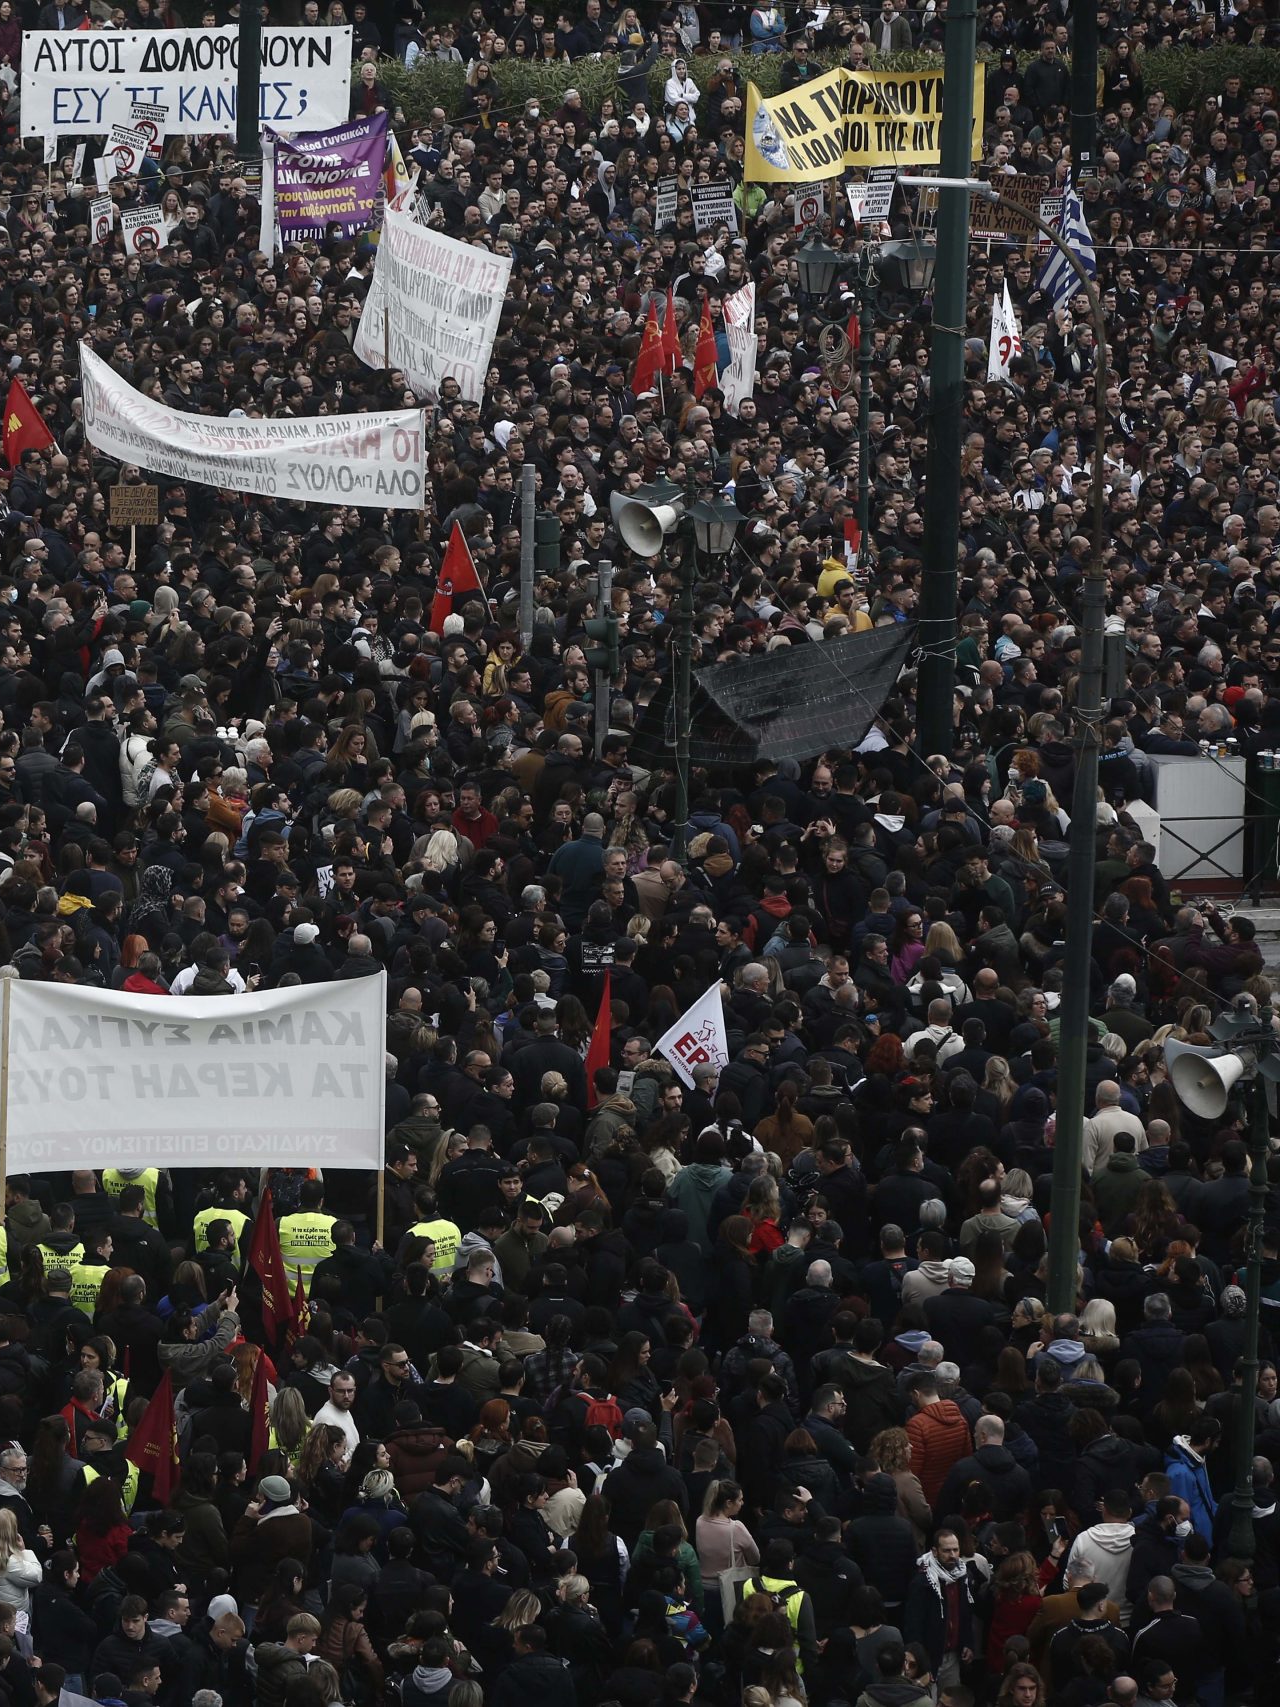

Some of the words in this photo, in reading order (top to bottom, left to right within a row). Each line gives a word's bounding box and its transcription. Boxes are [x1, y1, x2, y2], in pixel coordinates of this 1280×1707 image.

[34, 37, 126, 73] ΑΥΤΟΙ
[139, 35, 332, 73] ΔΟΛΟΦΟΥΝ
[53, 86, 110, 124] ΕΣΥ
[178, 82, 308, 122] ΚΑΝΙΣ;
[773, 100, 817, 139] ΝΑ
[809, 76, 945, 123] ΤΙΩΡΗΘΟΥ
[131, 113, 166, 124] ΔΟΛΟΦΟΝΩΝ
[133, 108, 165, 118] ΚΥΒΕΡΝΗΣΗ
[110, 136, 144, 152] ΔΟΛΟΦΟΝΩΝ
[113, 131, 145, 145] ΚΥΒΕΡΝΗΣΗ
[295, 142, 322, 154] μέρα
[322, 124, 370, 148] Γυναικών
[787, 144, 809, 172] ΟΙ
[875, 121, 908, 152] ΤΗΣ
[277, 150, 342, 169] ΡΓΟΥΜΕ
[277, 160, 371, 186] ΔΗΛΩΝΟΥΜΕ
[277, 192, 303, 205] τους
[303, 185, 357, 203] πλούσιους
[796, 185, 821, 195] ΚΥΒΕΡΝΗΣΗ
[872, 198, 889, 206] ΕΡΓΑΤΙΚΟ
[280, 208, 298, 218] την
[299, 199, 356, 220] κυβέρνησή
[124, 212, 160, 224] ΚΥΒΕΡΝΗΣΗ
[124, 218, 162, 230] ΔΟΛΟΦΟΝΩΝ
[697, 217, 707, 225] ΜΕ
[110, 487, 130, 497] ΠΟΤΕ
[130, 487, 146, 497] ΔΕΝ
[117, 498, 157, 507] ΞΕΧΑΣΟΥΜΕ
[110, 507, 120, 516] ΤΟ
[305, 1233, 317, 1241] ζωές
